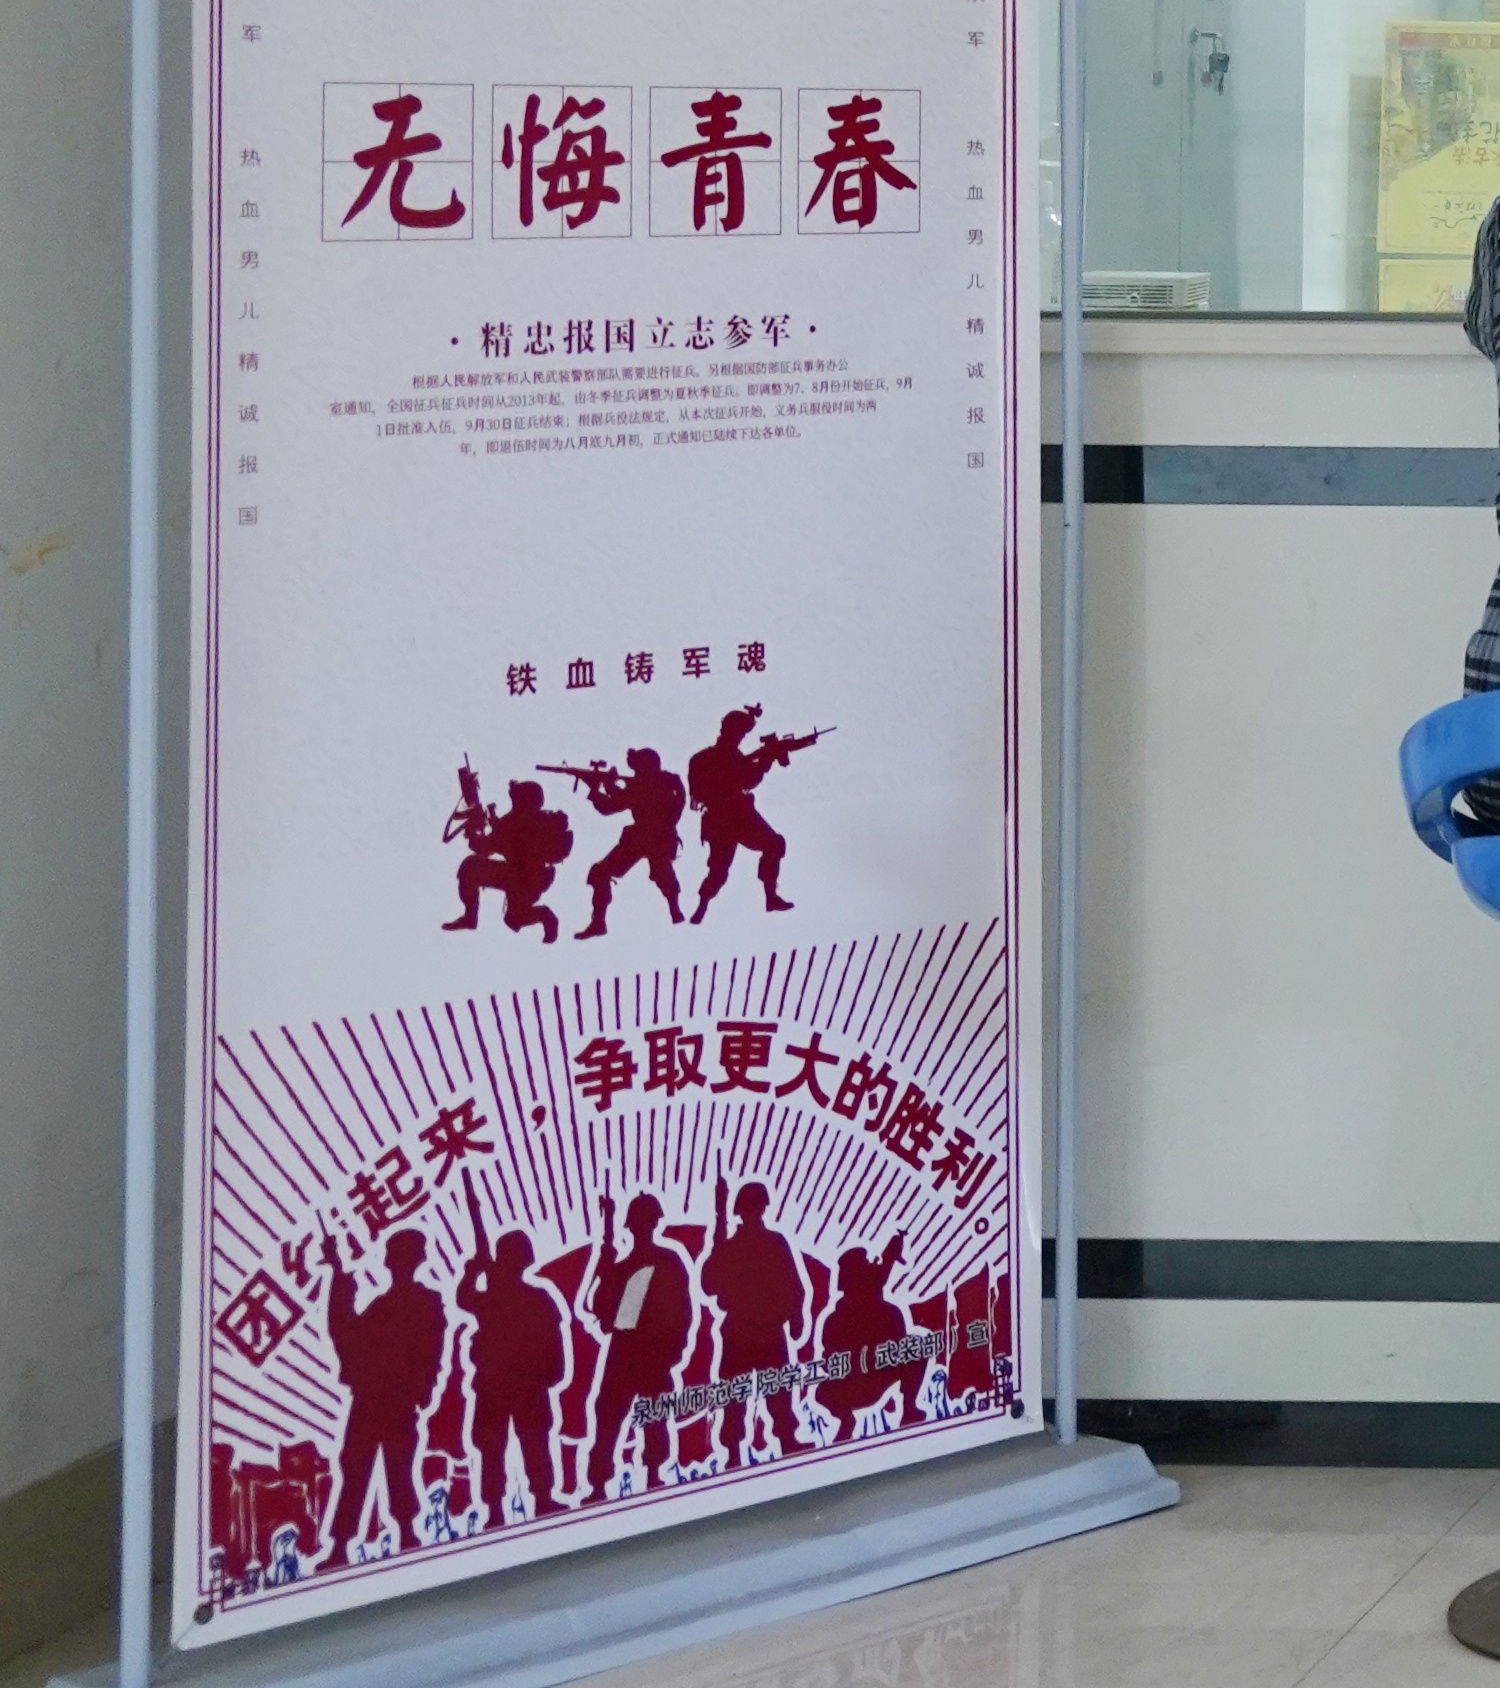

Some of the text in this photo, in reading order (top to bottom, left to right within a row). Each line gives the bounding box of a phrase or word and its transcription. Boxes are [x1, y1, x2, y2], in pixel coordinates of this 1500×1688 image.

[342, 92, 917, 232] 无悔青春
[505, 641, 767, 696] 铁血铸军魂
